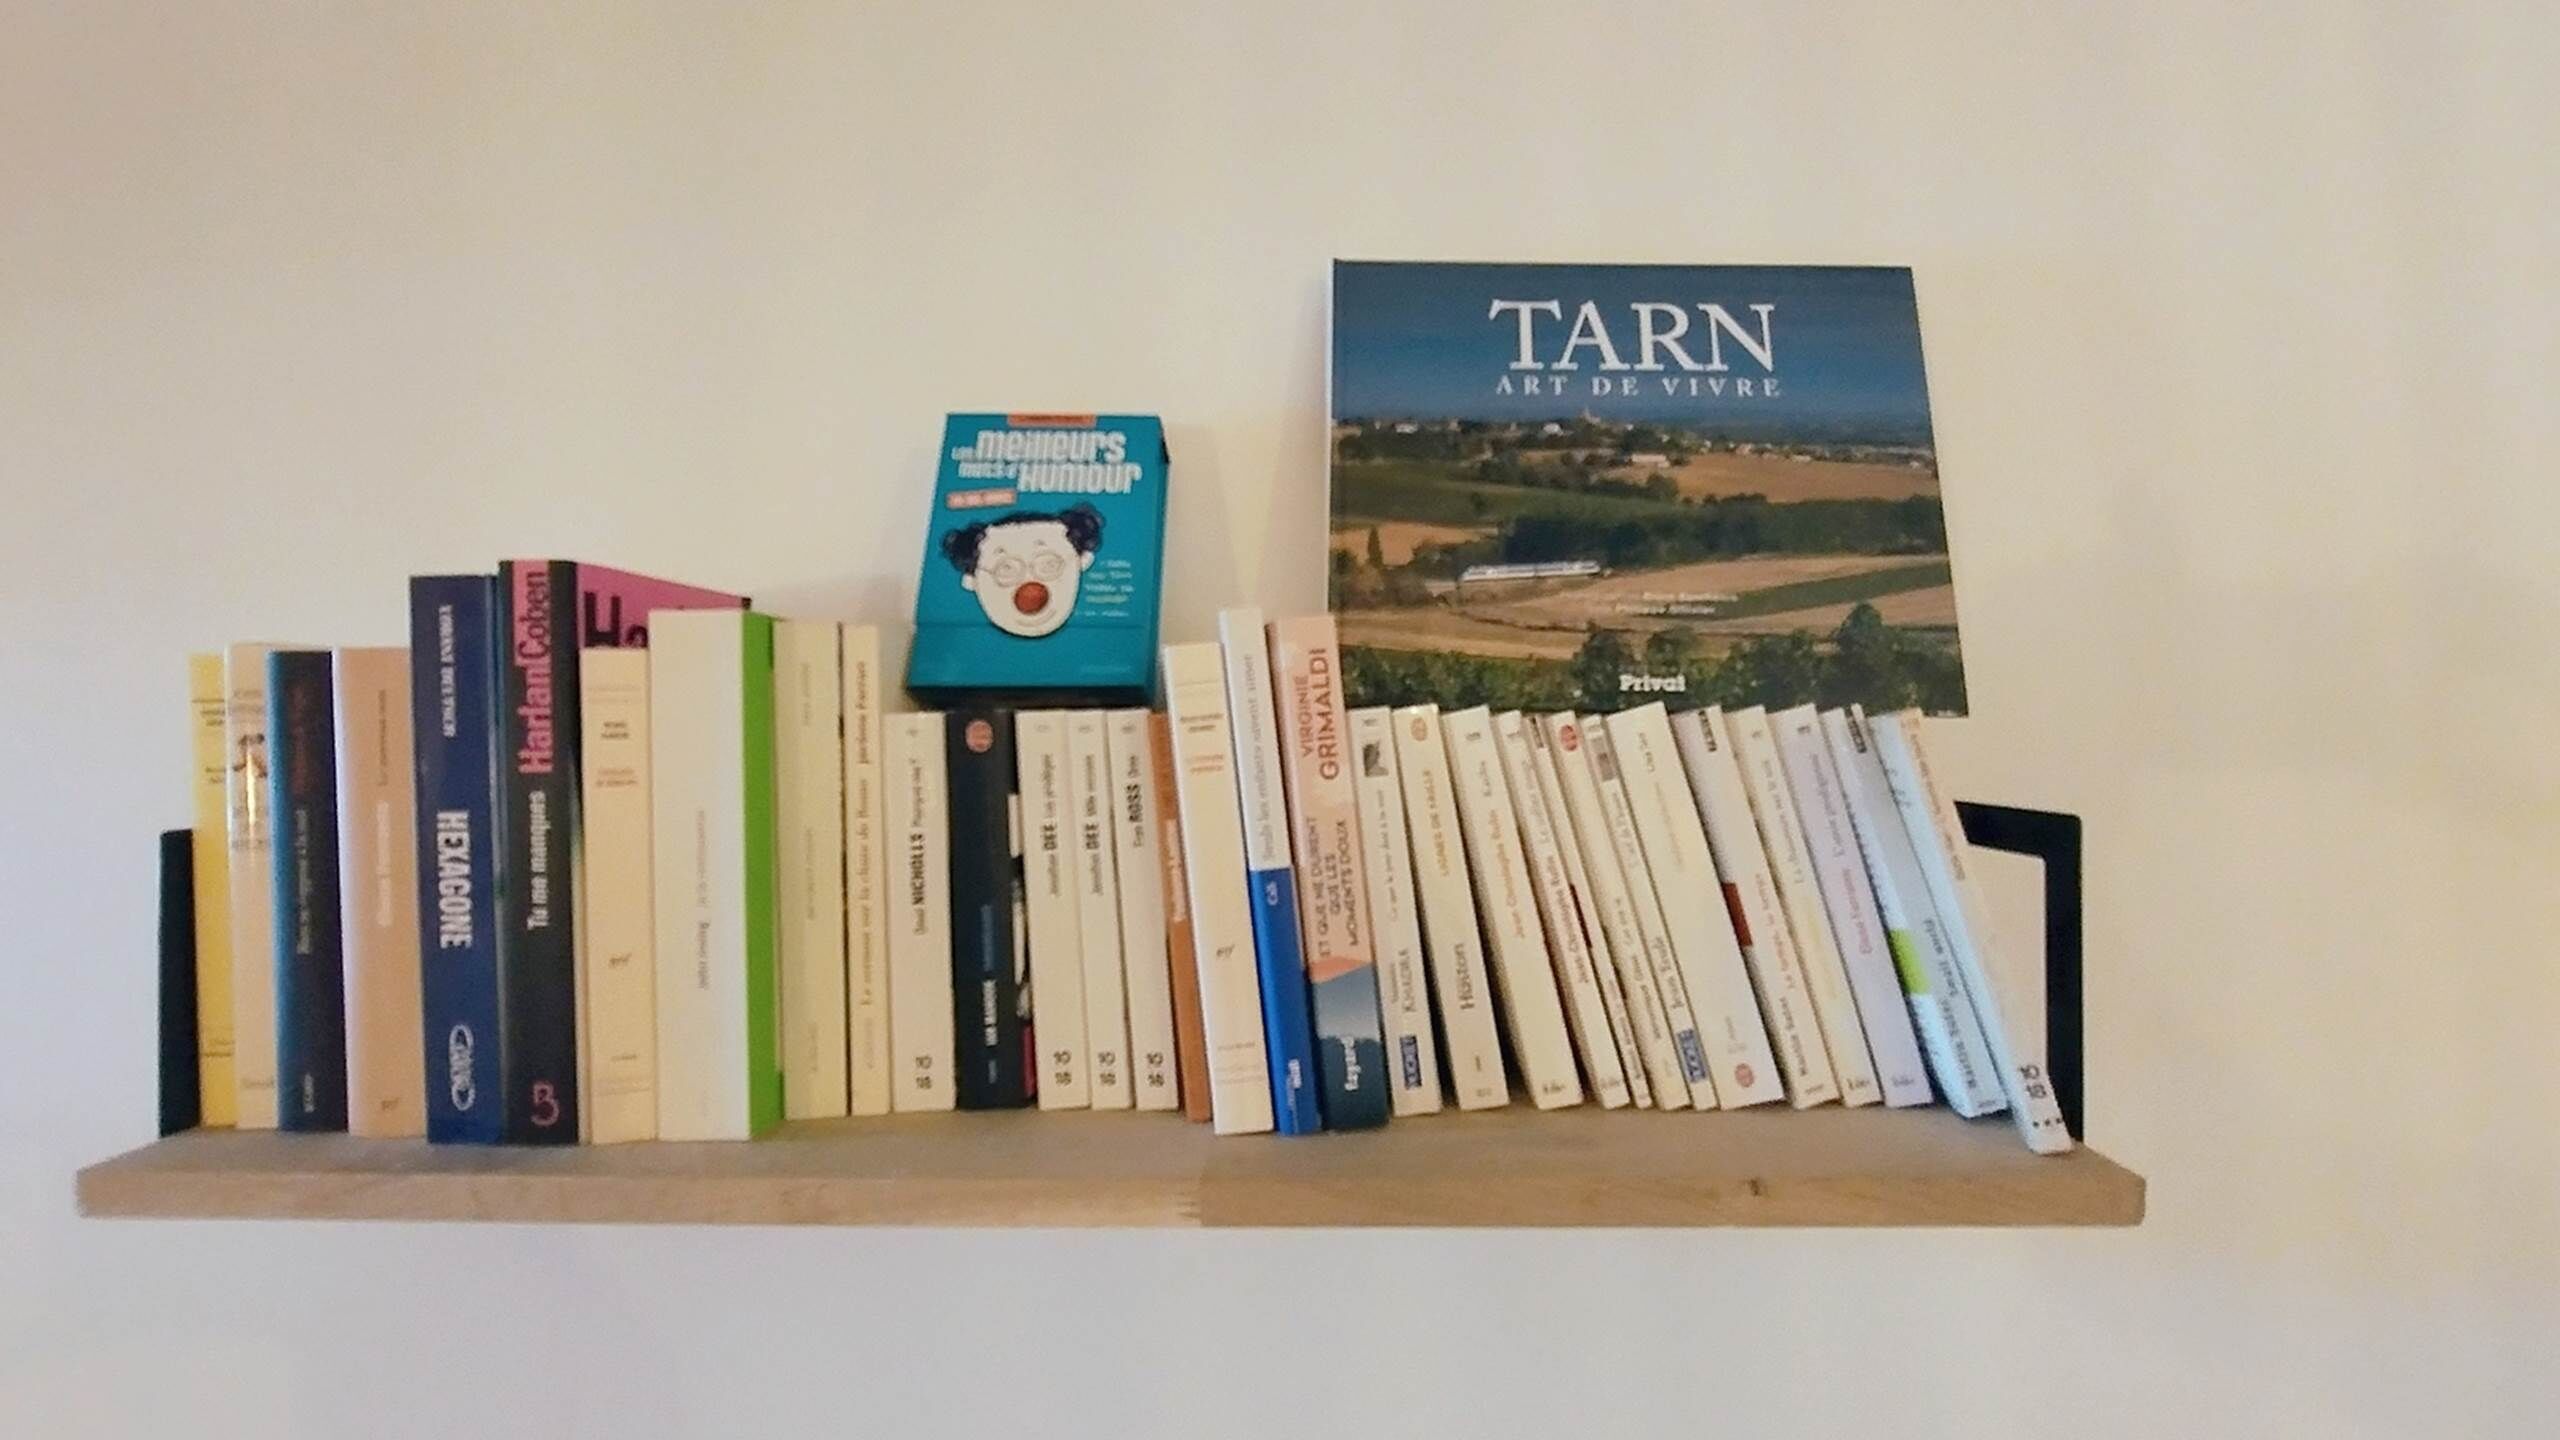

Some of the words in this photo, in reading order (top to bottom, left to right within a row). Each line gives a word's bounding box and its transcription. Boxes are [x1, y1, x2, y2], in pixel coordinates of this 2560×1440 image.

[1488, 299, 1777, 371] TARN
[1496, 375, 1567, 396] ART
[1592, 376, 1639, 396] DE
[1661, 377, 1781, 396] VIVRE
[1293, 675, 1314, 757] VIRGINIE
[1308, 648, 1340, 780] GRIMALDI
[528, 790, 552, 873] manques
[1125, 783, 1143, 823] ROSS
[436, 811, 472, 948] HEXAGONE
[529, 875, 548, 904] me
[908, 834, 925, 905] NICHOLLS
[526, 910, 549, 931] Tu
